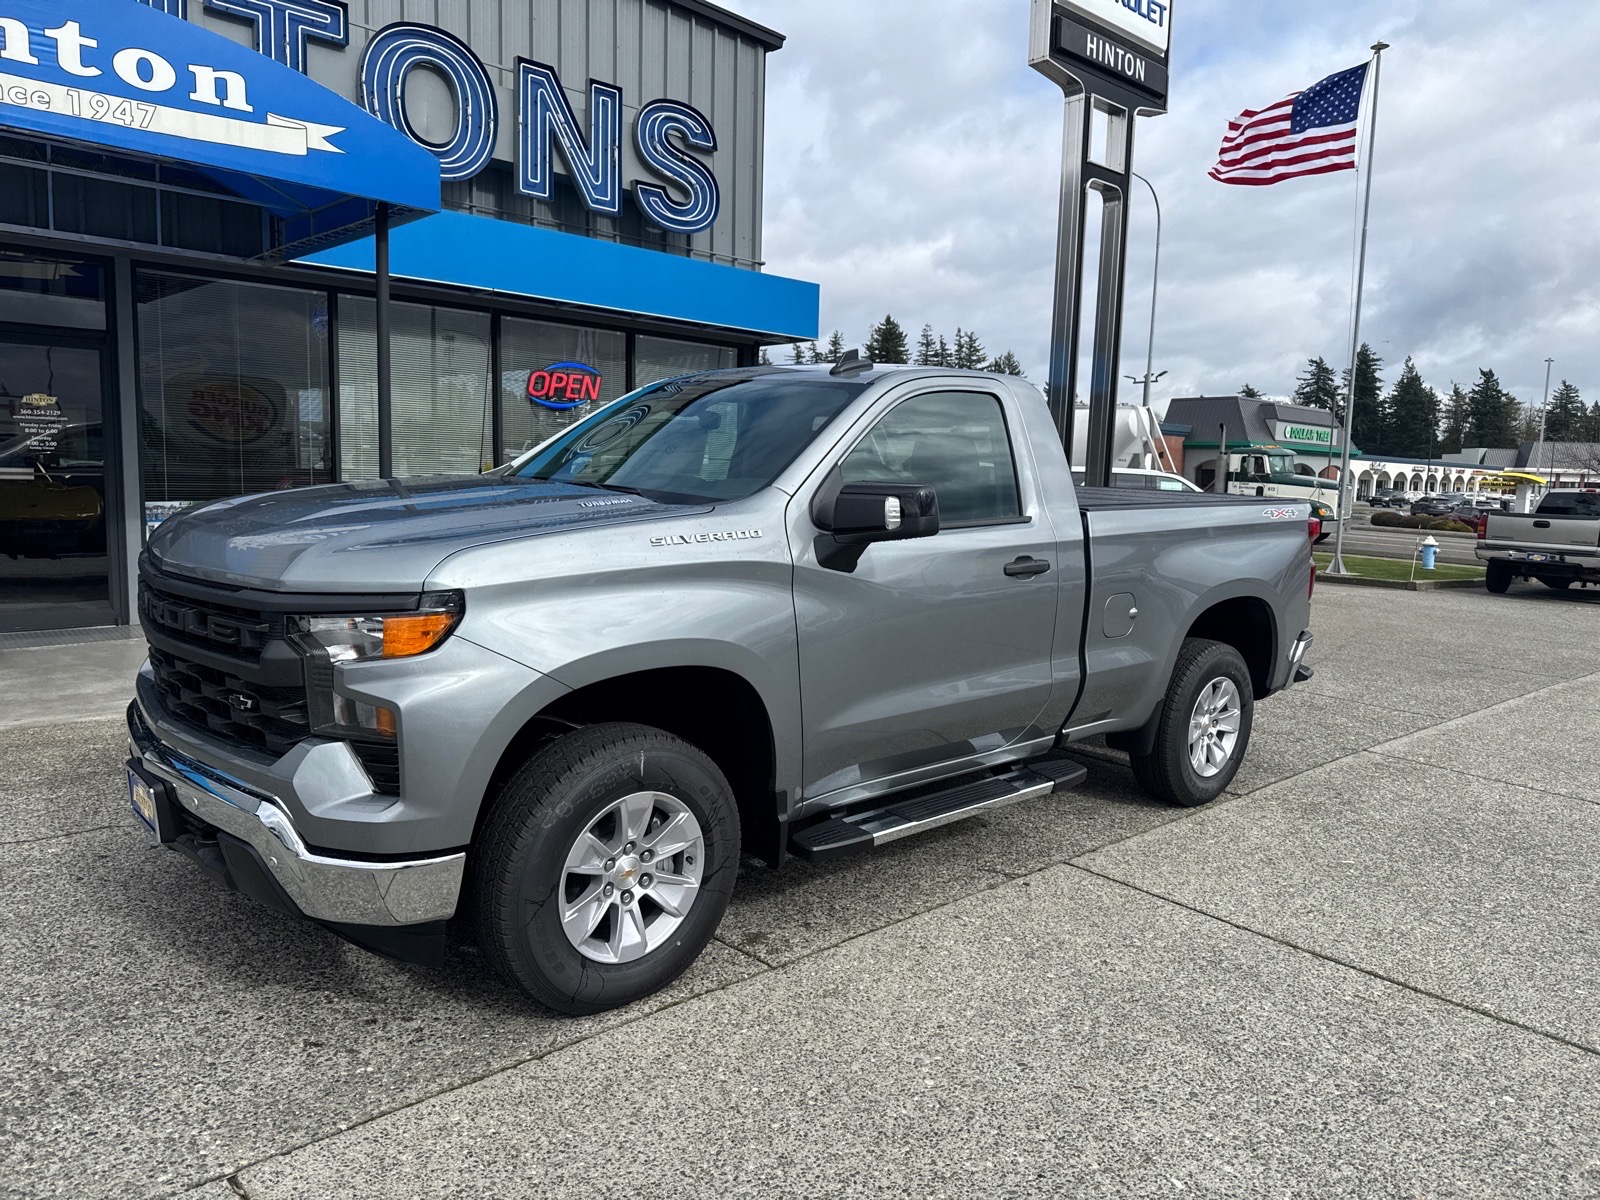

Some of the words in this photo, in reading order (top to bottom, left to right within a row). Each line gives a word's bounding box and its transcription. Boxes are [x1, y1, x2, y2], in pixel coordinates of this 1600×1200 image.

[1086, 33, 1146, 82] HINTON
[67, 89, 157, 129] 1947
[135, 0, 720, 234] TONS
[528, 370, 602, 400] OPEN
[578, 498, 632, 509] TURBOMAX
[650, 529, 763, 547] SILVERADO
[144, 592, 269, 648] ROLET
